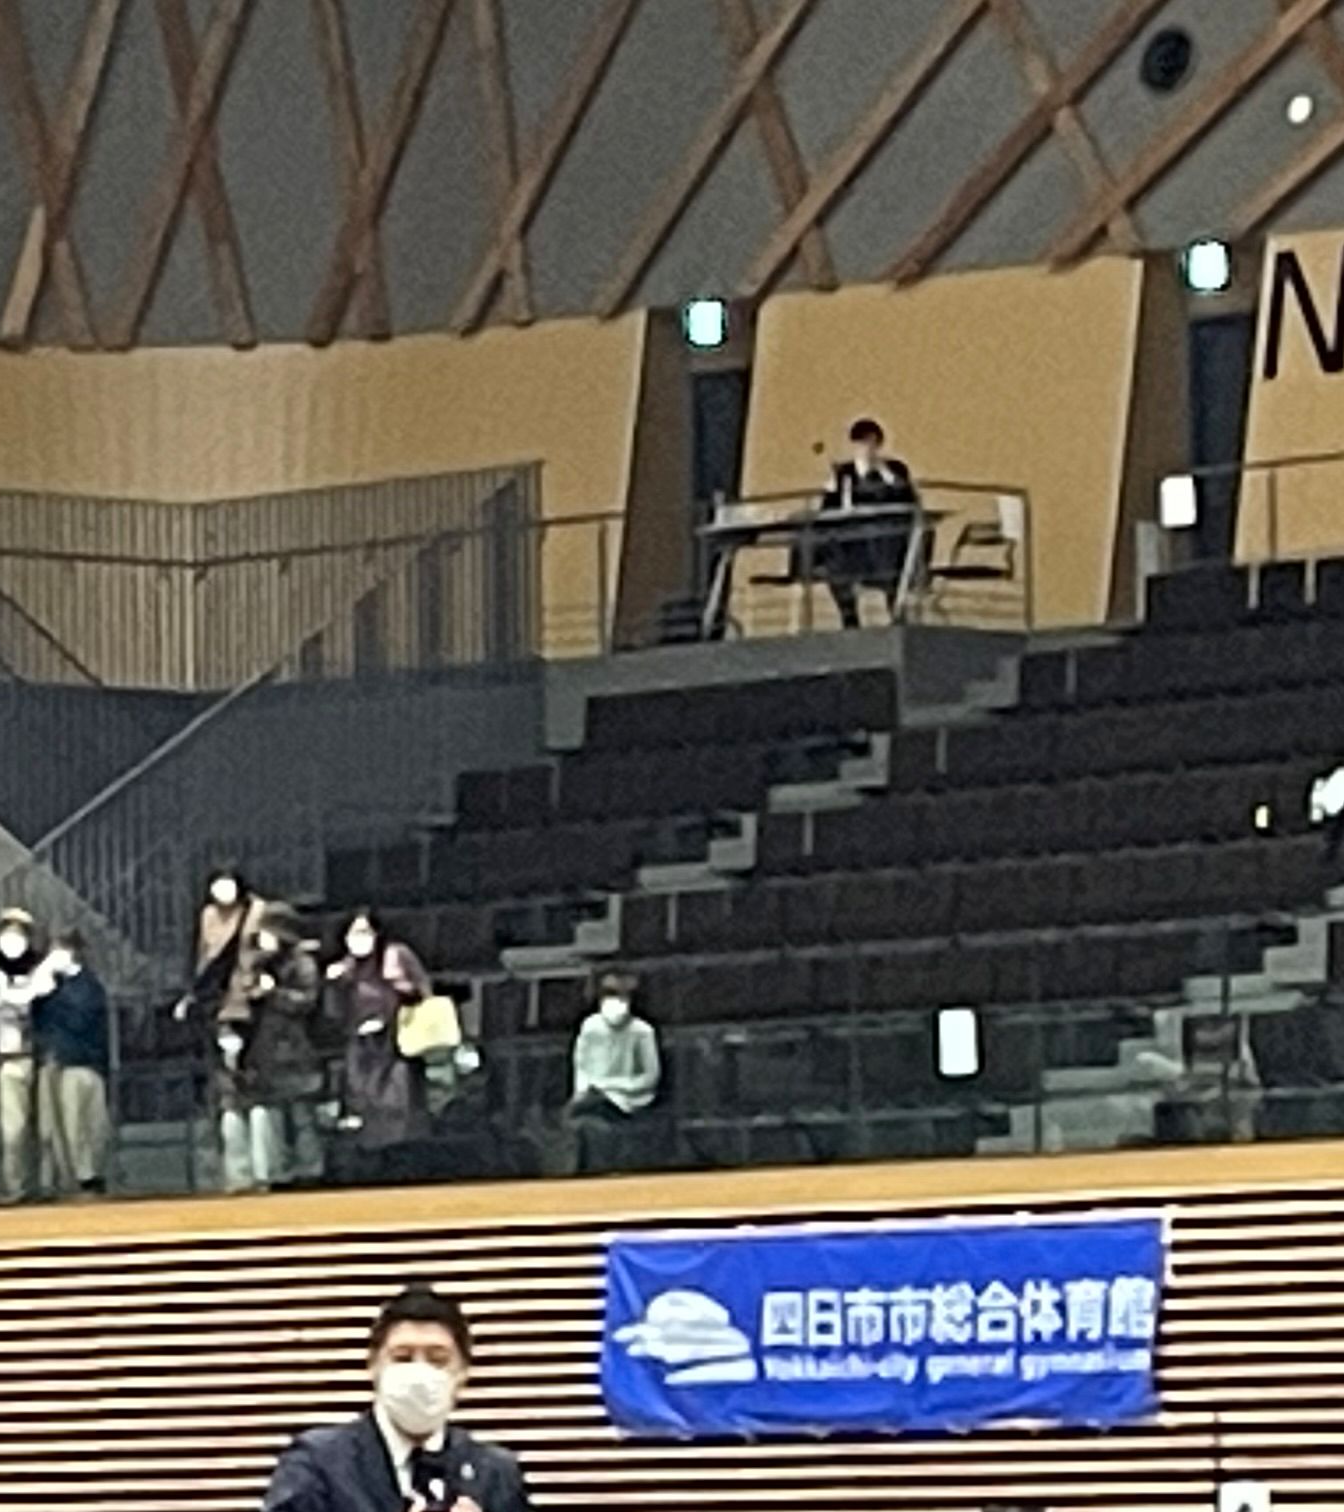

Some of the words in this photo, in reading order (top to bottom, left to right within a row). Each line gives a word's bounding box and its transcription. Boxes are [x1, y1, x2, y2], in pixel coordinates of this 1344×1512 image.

[761, 1277, 1156, 1347] 四日市市総合体育館
